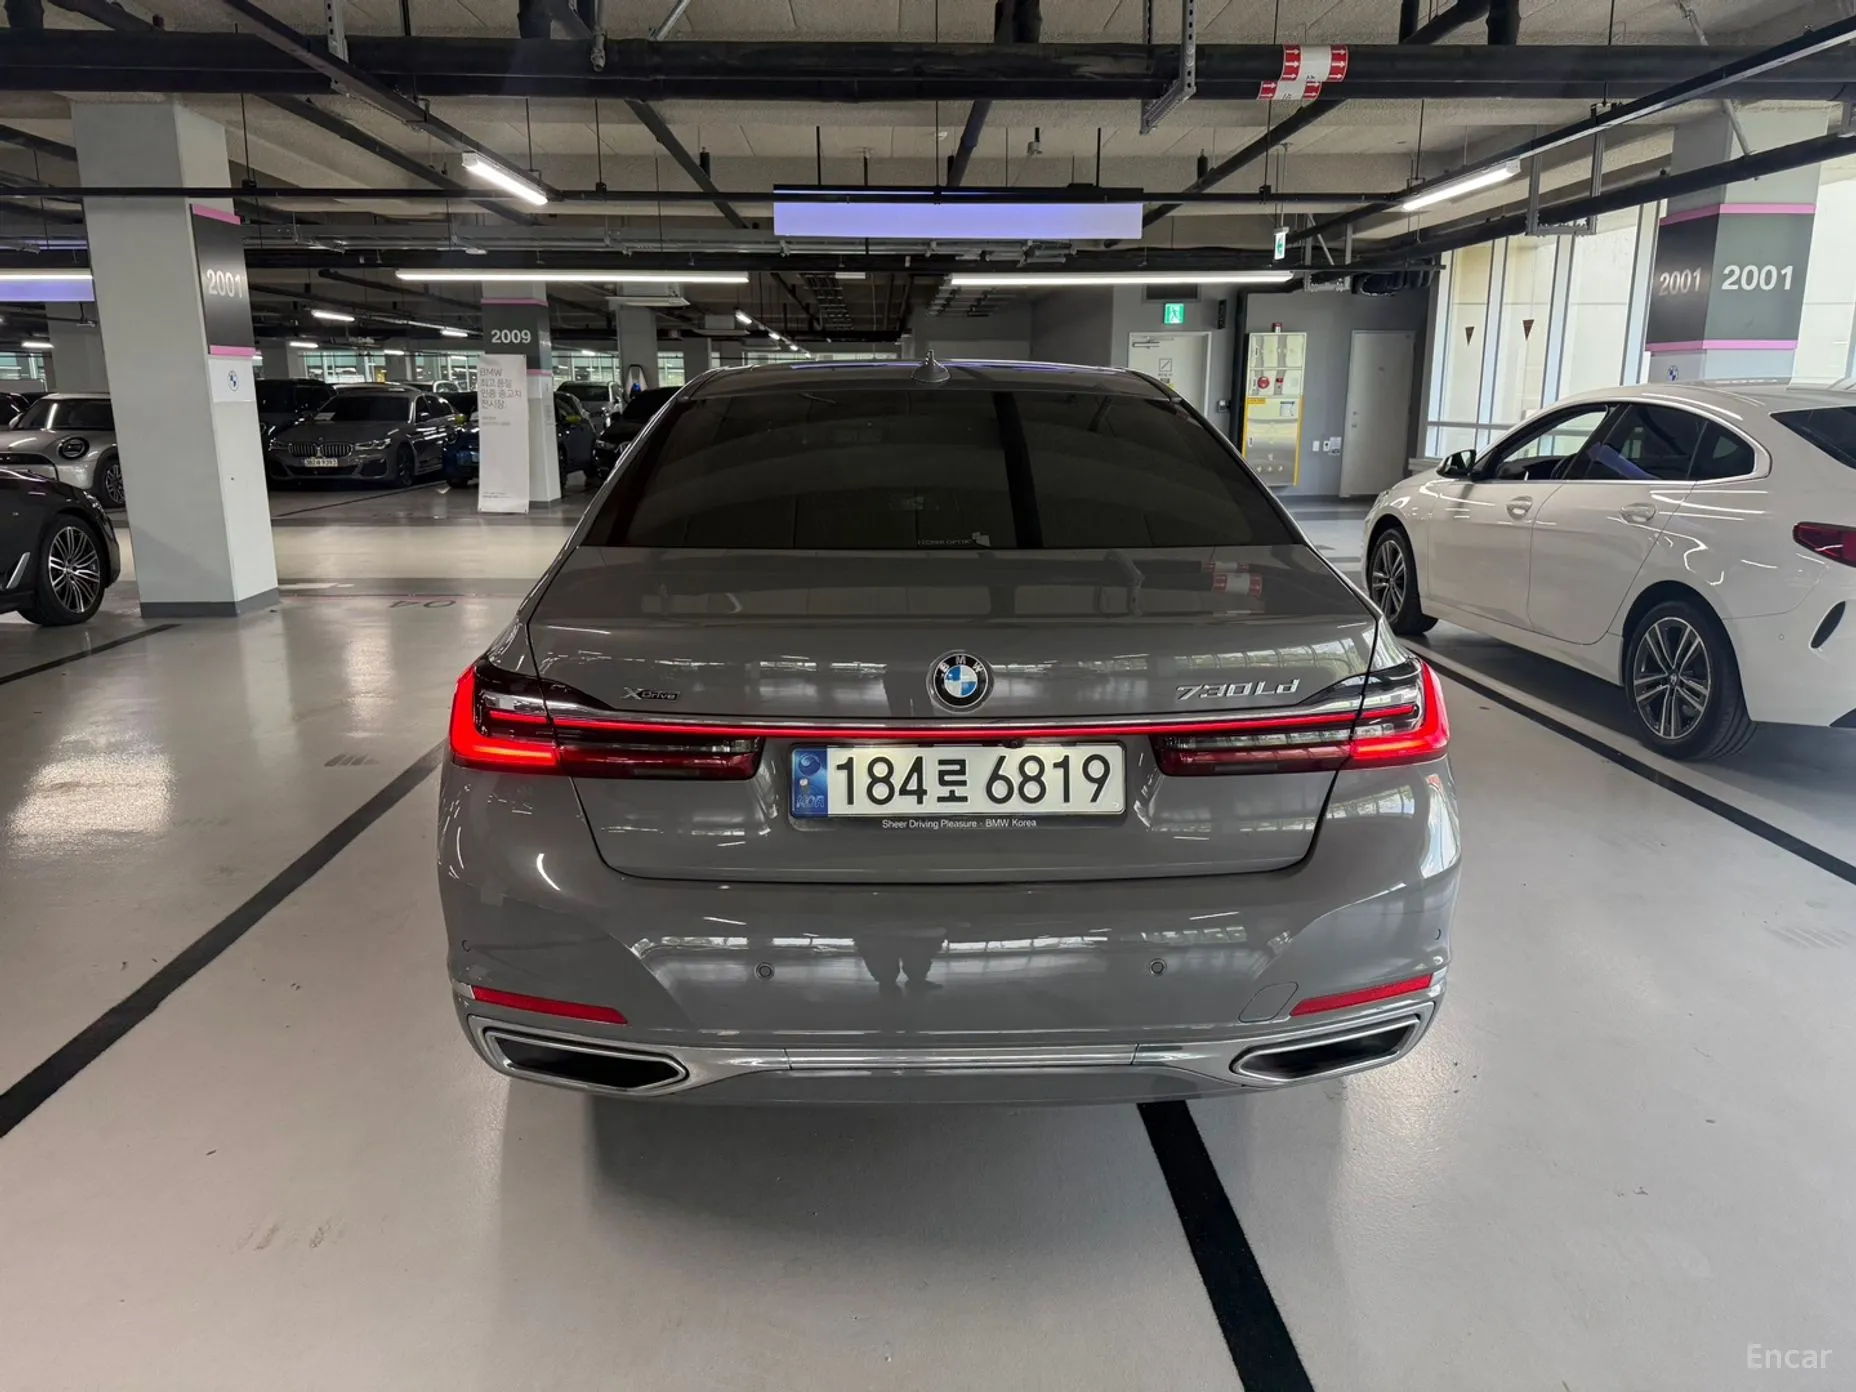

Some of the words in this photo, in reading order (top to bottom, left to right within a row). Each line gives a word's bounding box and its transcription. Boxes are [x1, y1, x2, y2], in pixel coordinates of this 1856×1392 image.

[207, 269, 243, 298] 2001
[1659, 268, 1702, 296] 2001
[1721, 264, 1794, 291] 2001
[491, 329, 532, 344] 2009
[479, 367, 502, 377] BMW
[481, 399, 505, 410] 전시장
[938, 655, 985, 673] BMW
[1176, 679, 1300, 701] 730Ld
[836, 755, 968, 806] 184로
[985, 753, 1111, 805] 6819
[882, 819, 907, 829] Sheer
[909, 819, 939, 830] Driving
[940, 819, 977, 829] Pleasure
[985, 818, 1010, 828] BMW
[1011, 818, 1037, 828] Korea
